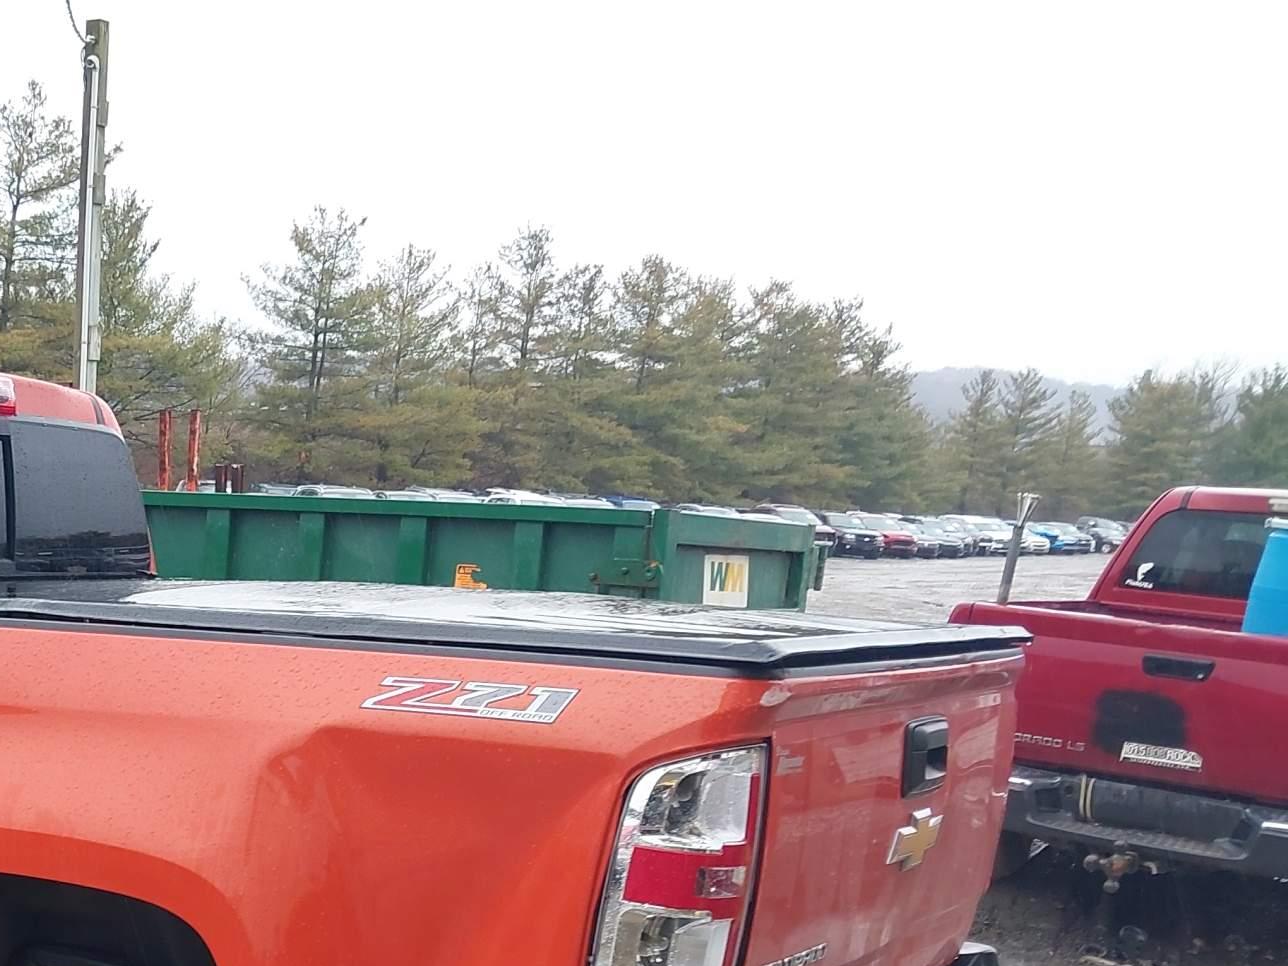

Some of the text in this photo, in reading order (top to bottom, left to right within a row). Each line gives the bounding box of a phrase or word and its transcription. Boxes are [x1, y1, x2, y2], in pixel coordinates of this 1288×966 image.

[710, 561, 744, 592] WM
[360, 676, 580, 717] Z71
[479, 709, 555, 721] OFF ROAD
[1066, 740, 1086, 752] LS
